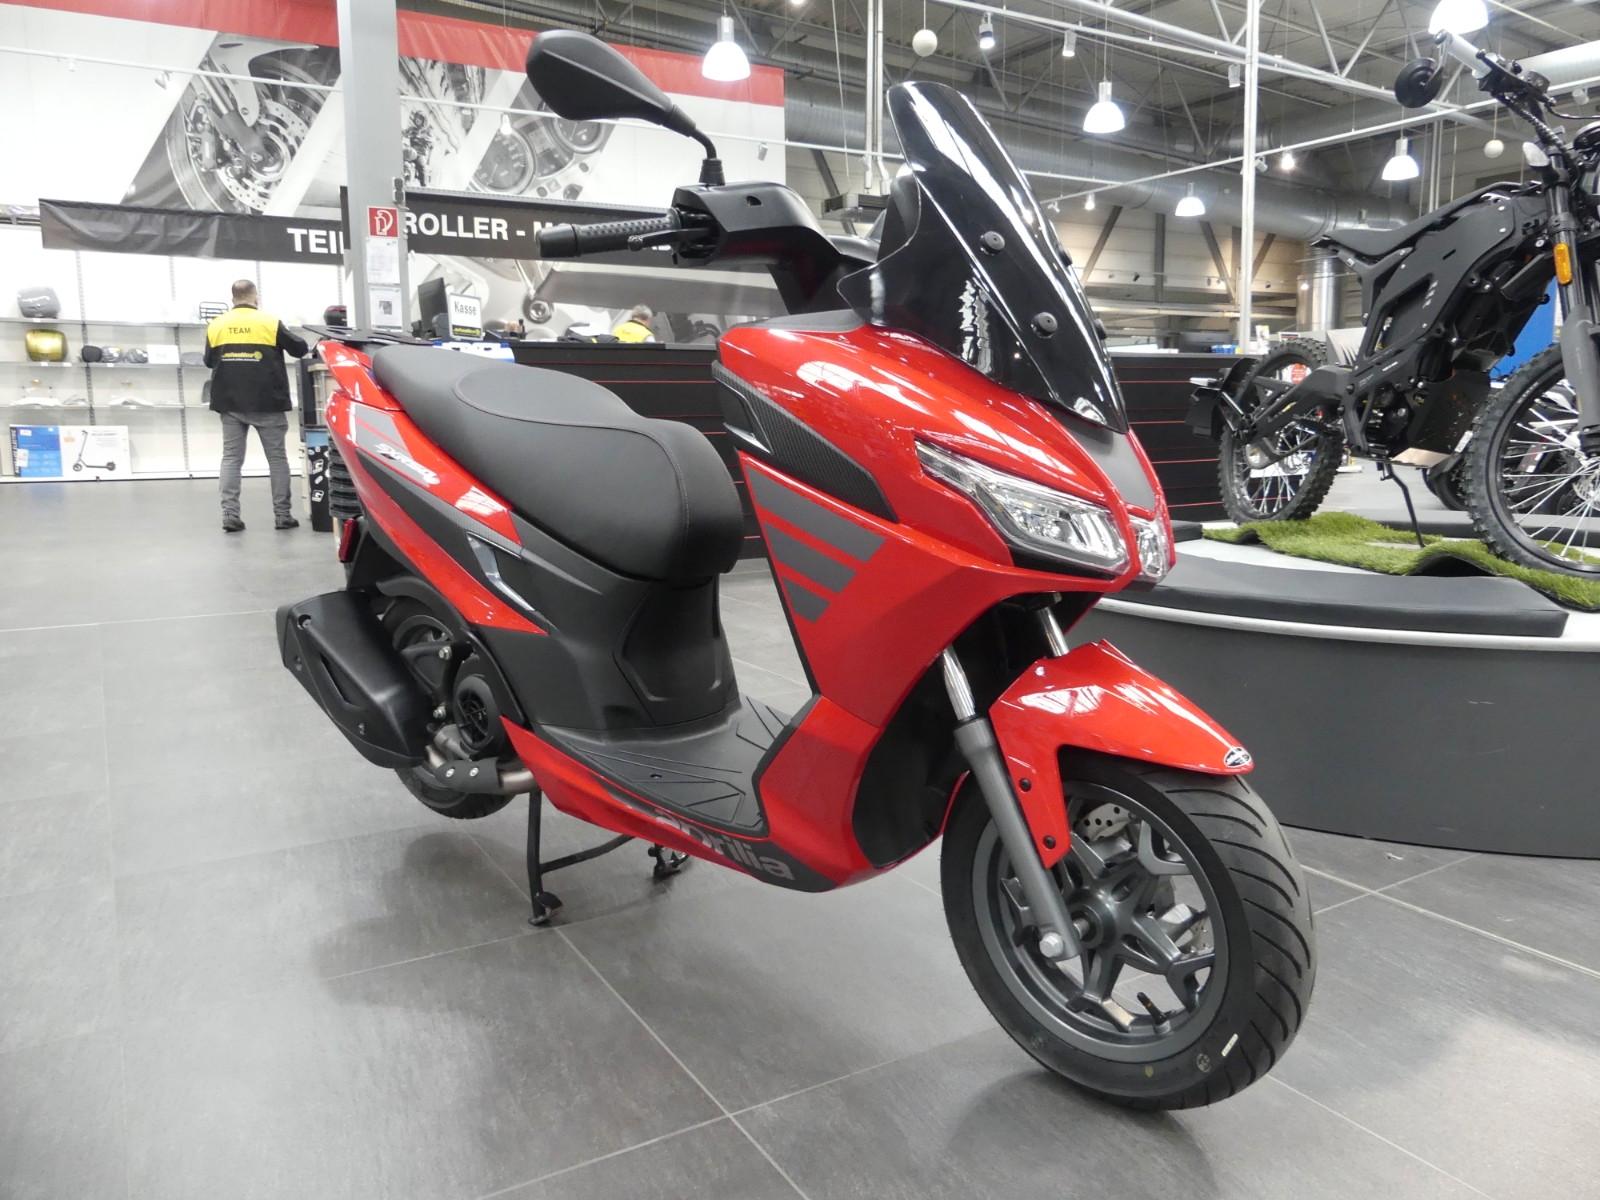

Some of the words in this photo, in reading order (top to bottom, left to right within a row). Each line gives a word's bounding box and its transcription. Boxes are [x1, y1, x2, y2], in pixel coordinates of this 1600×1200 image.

[404, 212, 508, 241] ROLLER
[454, 301, 477, 316] Kasse
[228, 327, 251, 335] TEAM
